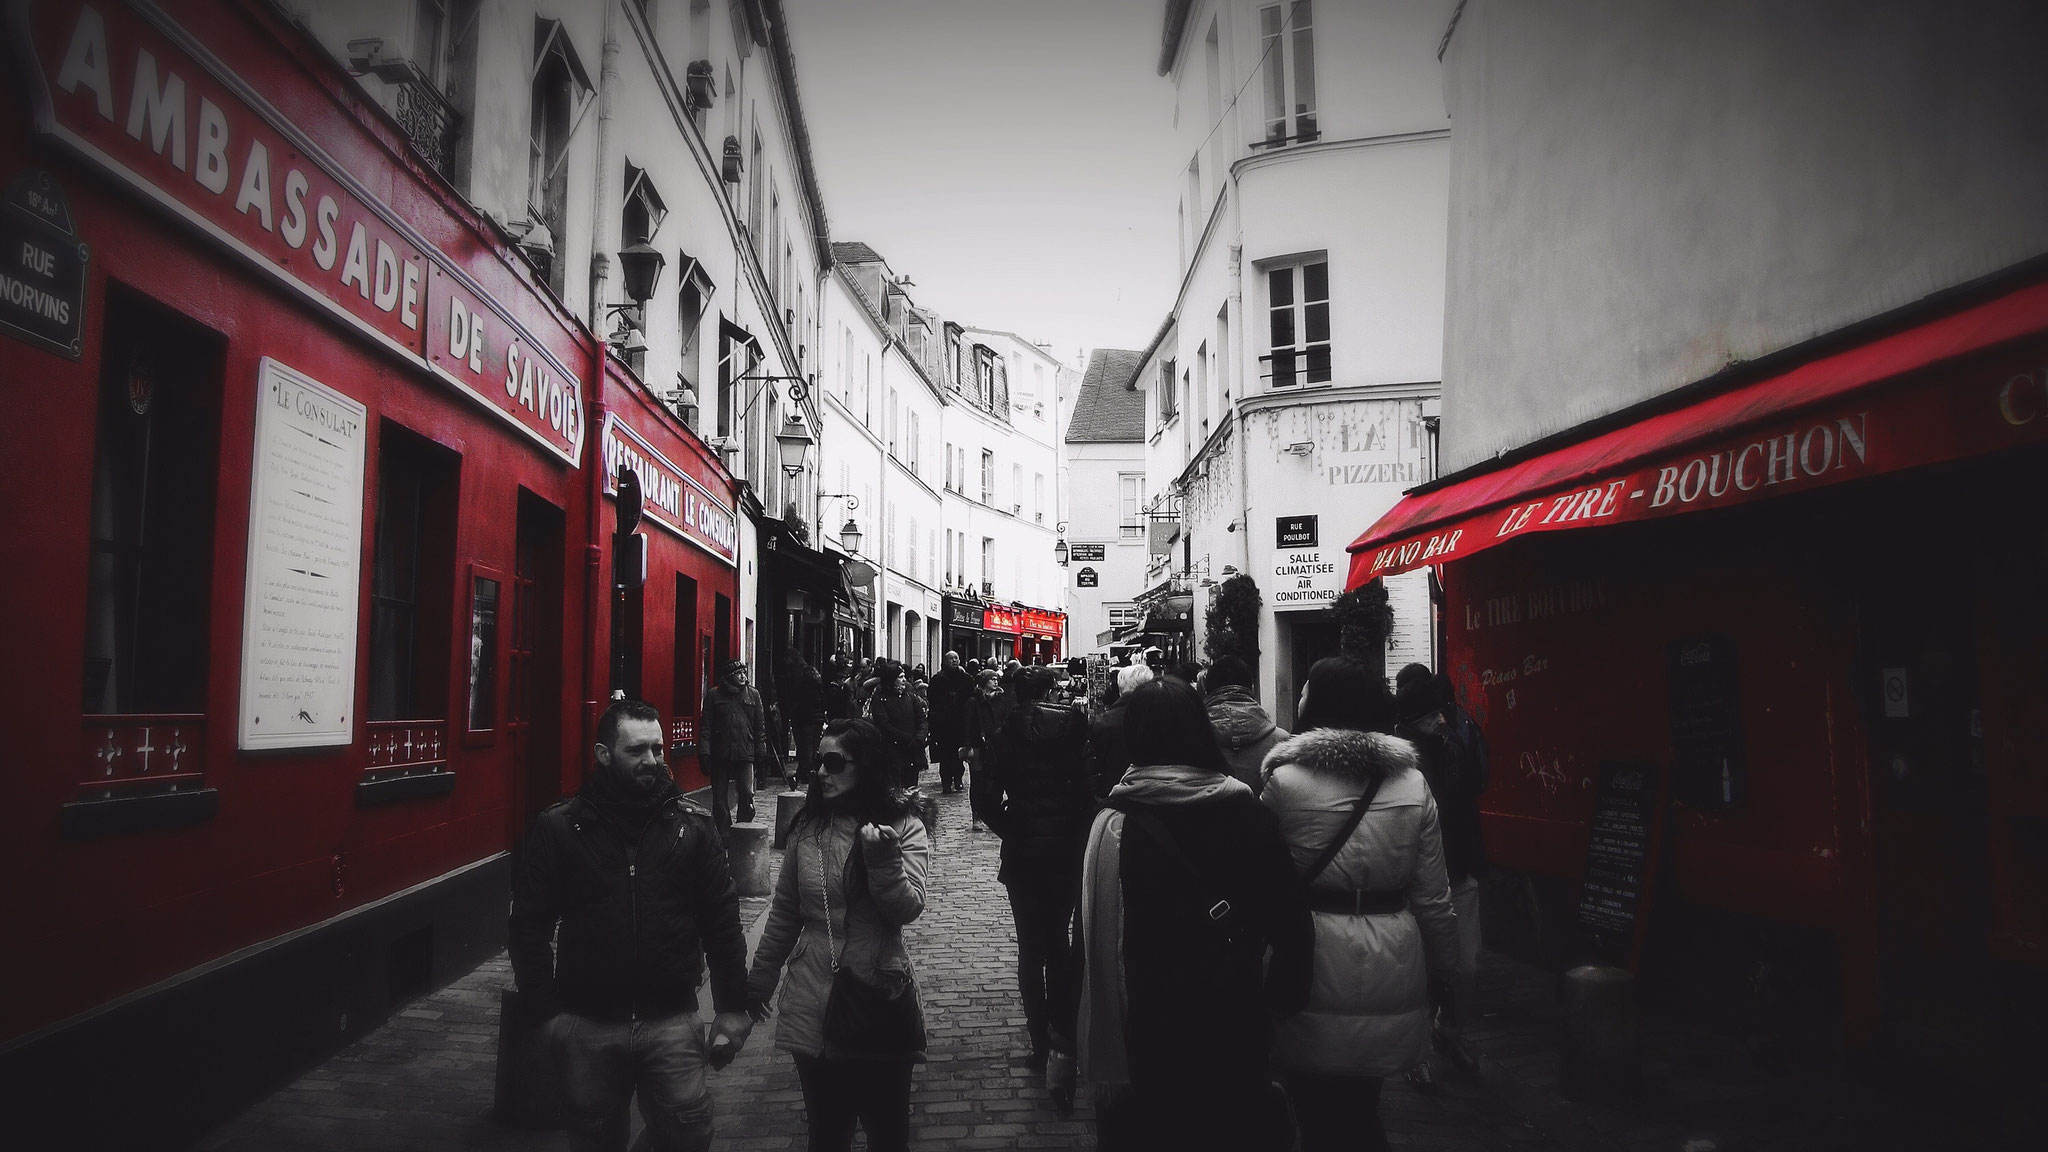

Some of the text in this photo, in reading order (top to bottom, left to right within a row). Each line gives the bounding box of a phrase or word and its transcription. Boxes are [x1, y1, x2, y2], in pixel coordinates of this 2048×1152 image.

[56, 6, 577, 445] AMBASSADE DE SAVOIE
[22, 242, 56, 279] RUE
[0, 273, 70, 325] NORVINS
[1340, 423, 1385, 452] LA
[1496, 502, 1543, 538] LE
[1539, 480, 1627, 525] TIRE
[1648, 411, 1869, 509] BOUCHON
[606, 432, 734, 553] RESTAURANT LE CONSULAT
[1283, 533, 1310, 542] POULBOT
[1290, 523, 1303, 531] RUE
[1275, 562, 1334, 576] CLIMATISÉE
[1290, 553, 1320, 563] SALLE
[1369, 529, 1463, 574] PIANO BAR
[1275, 590, 1335, 602] CONDITIONED
[1297, 580, 1312, 589] AIR
[1465, 604, 1480, 631] Le
[1486, 596, 1521, 627] TIRE
[1481, 655, 1550, 691] Piano Bar
